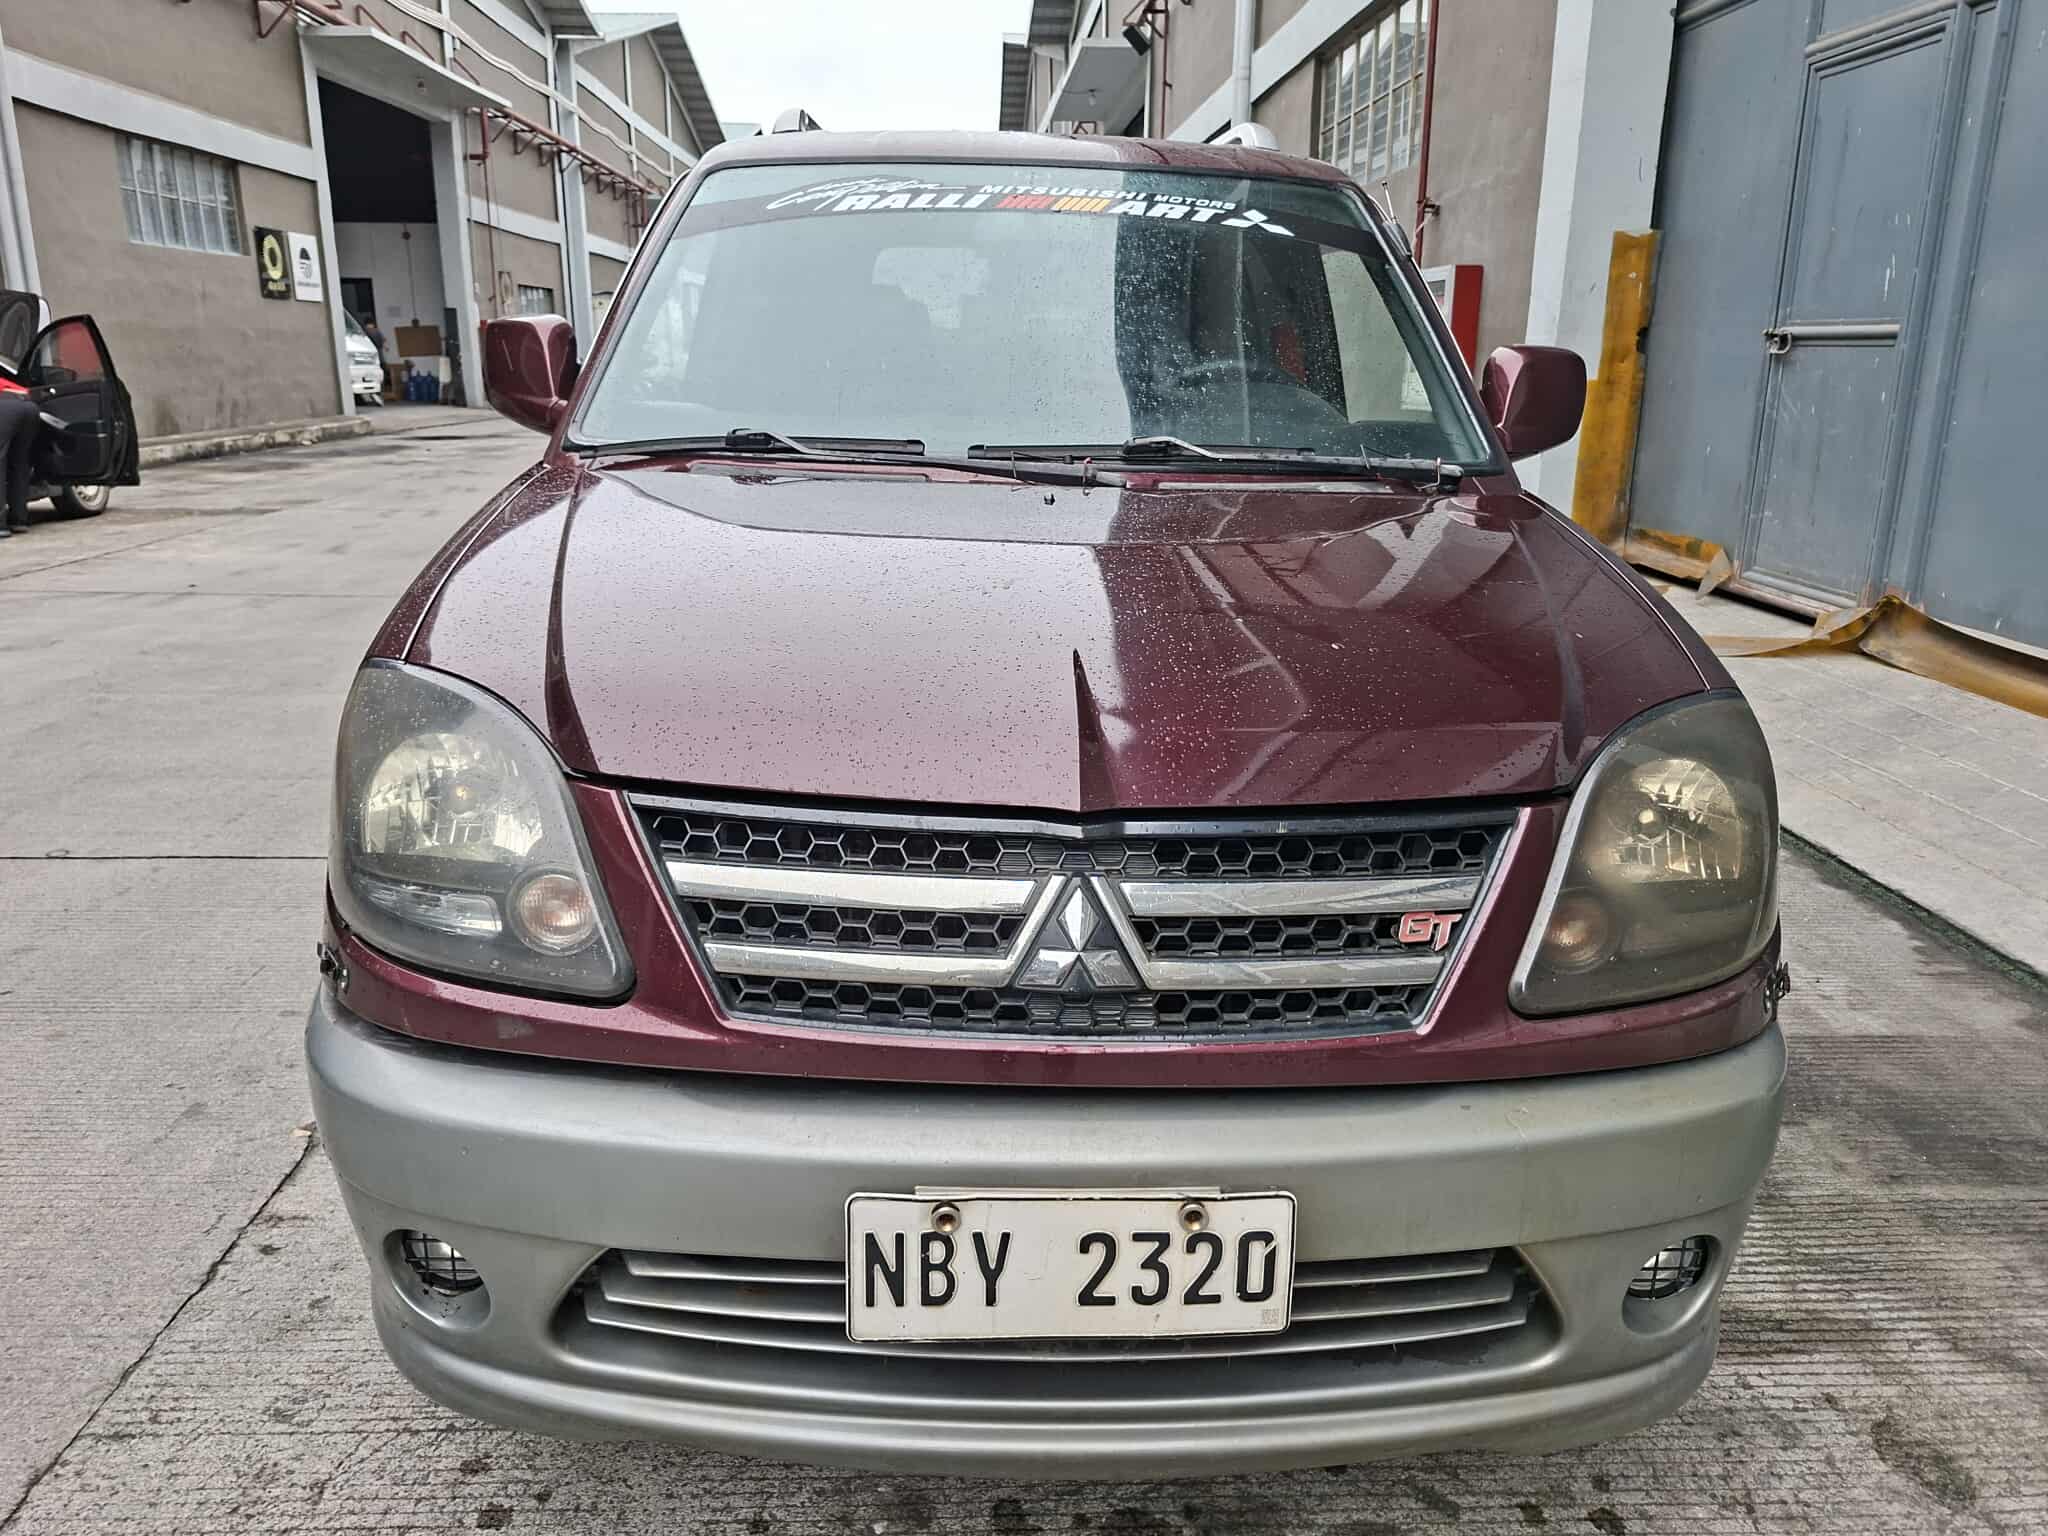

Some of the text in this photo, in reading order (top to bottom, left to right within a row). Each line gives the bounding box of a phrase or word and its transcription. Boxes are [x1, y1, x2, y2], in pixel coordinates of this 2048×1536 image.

[832, 193, 992, 212] RALLI
[1108, 200, 1226, 223] ART
[979, 184, 1147, 201] MITSUBISHI
[1153, 195, 1237, 210] MOTORS
[1399, 912, 1463, 951] GT
[864, 1230, 1278, 1308] NBY 2320
